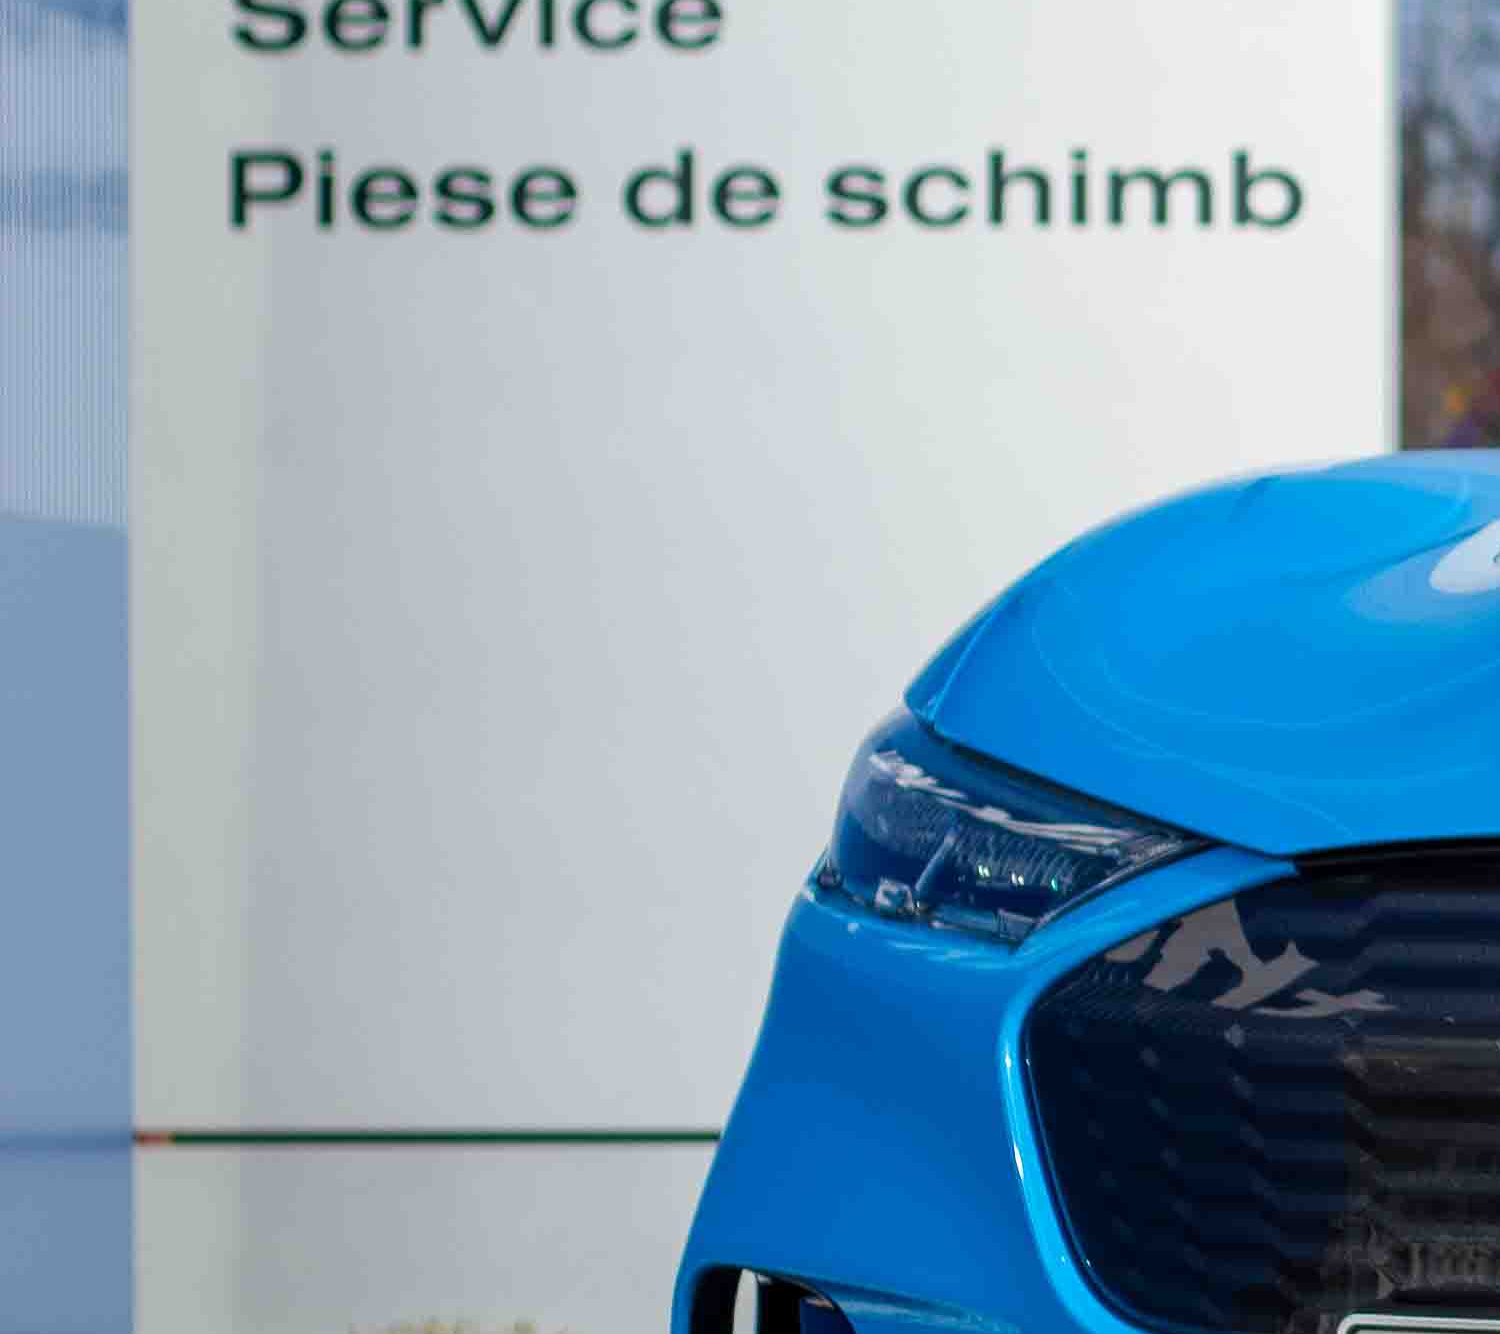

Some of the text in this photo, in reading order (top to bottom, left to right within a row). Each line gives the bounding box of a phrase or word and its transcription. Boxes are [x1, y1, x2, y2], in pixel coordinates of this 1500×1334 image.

[227, 147, 1305, 232] Piese de schimb
